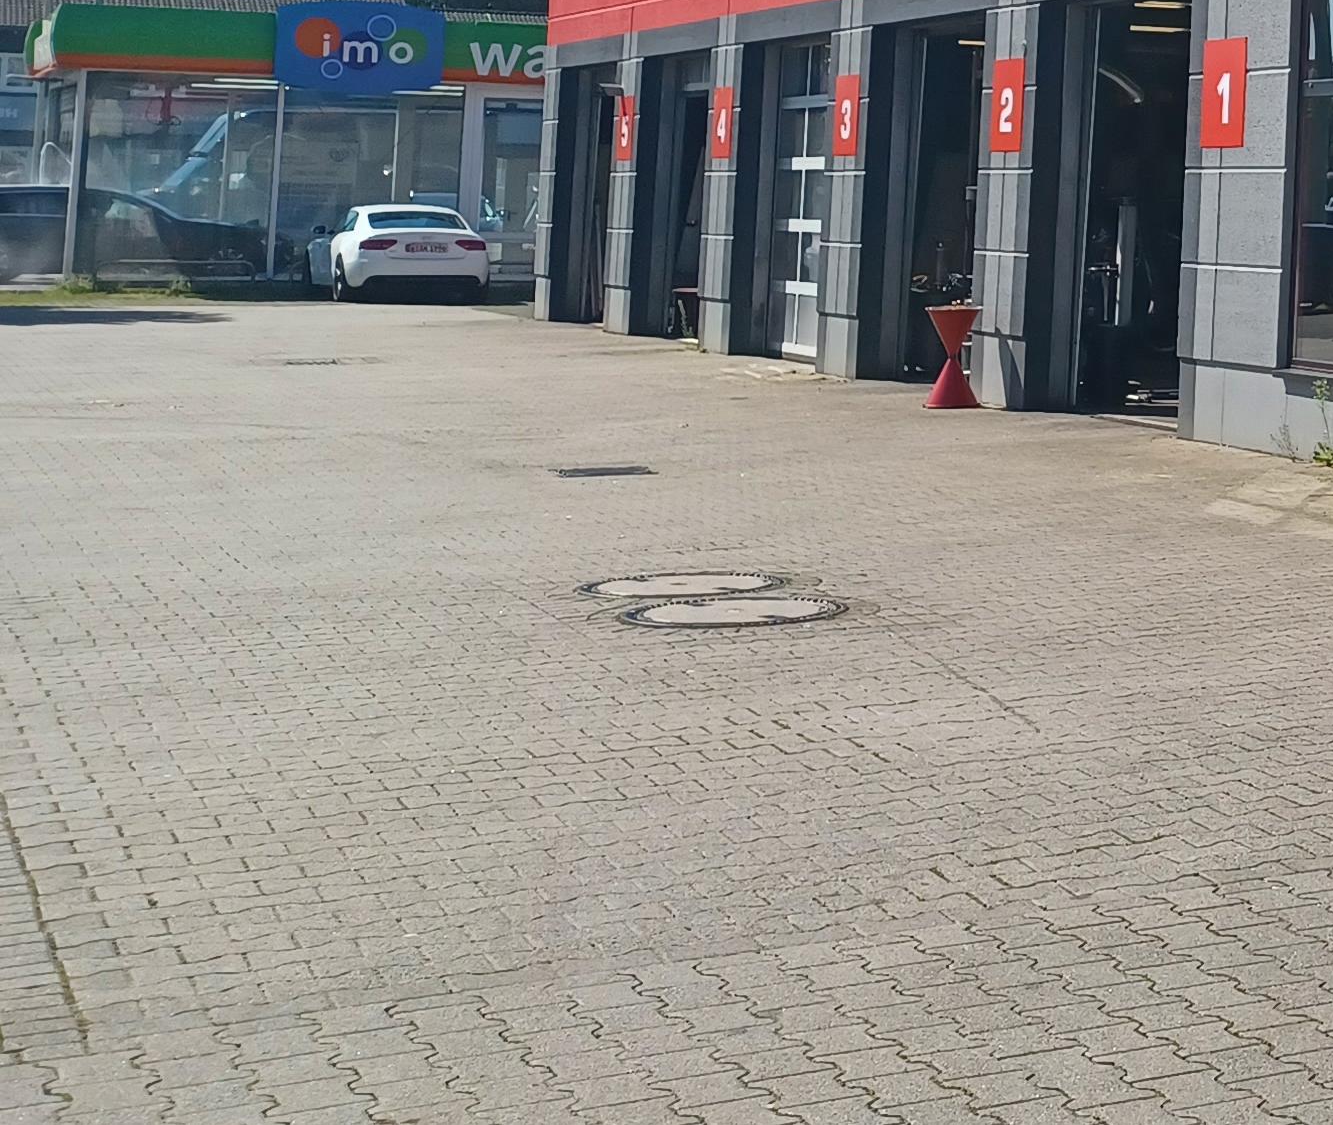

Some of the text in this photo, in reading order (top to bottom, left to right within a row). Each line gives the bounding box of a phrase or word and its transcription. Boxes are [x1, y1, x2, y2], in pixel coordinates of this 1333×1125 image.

[322, 33, 414, 64] imo
[1000, 87, 1014, 133] 2
[1215, 72, 1230, 125] 1
[619, 113, 630, 147] 5
[715, 108, 727, 143] 4
[840, 98, 852, 141] 3
